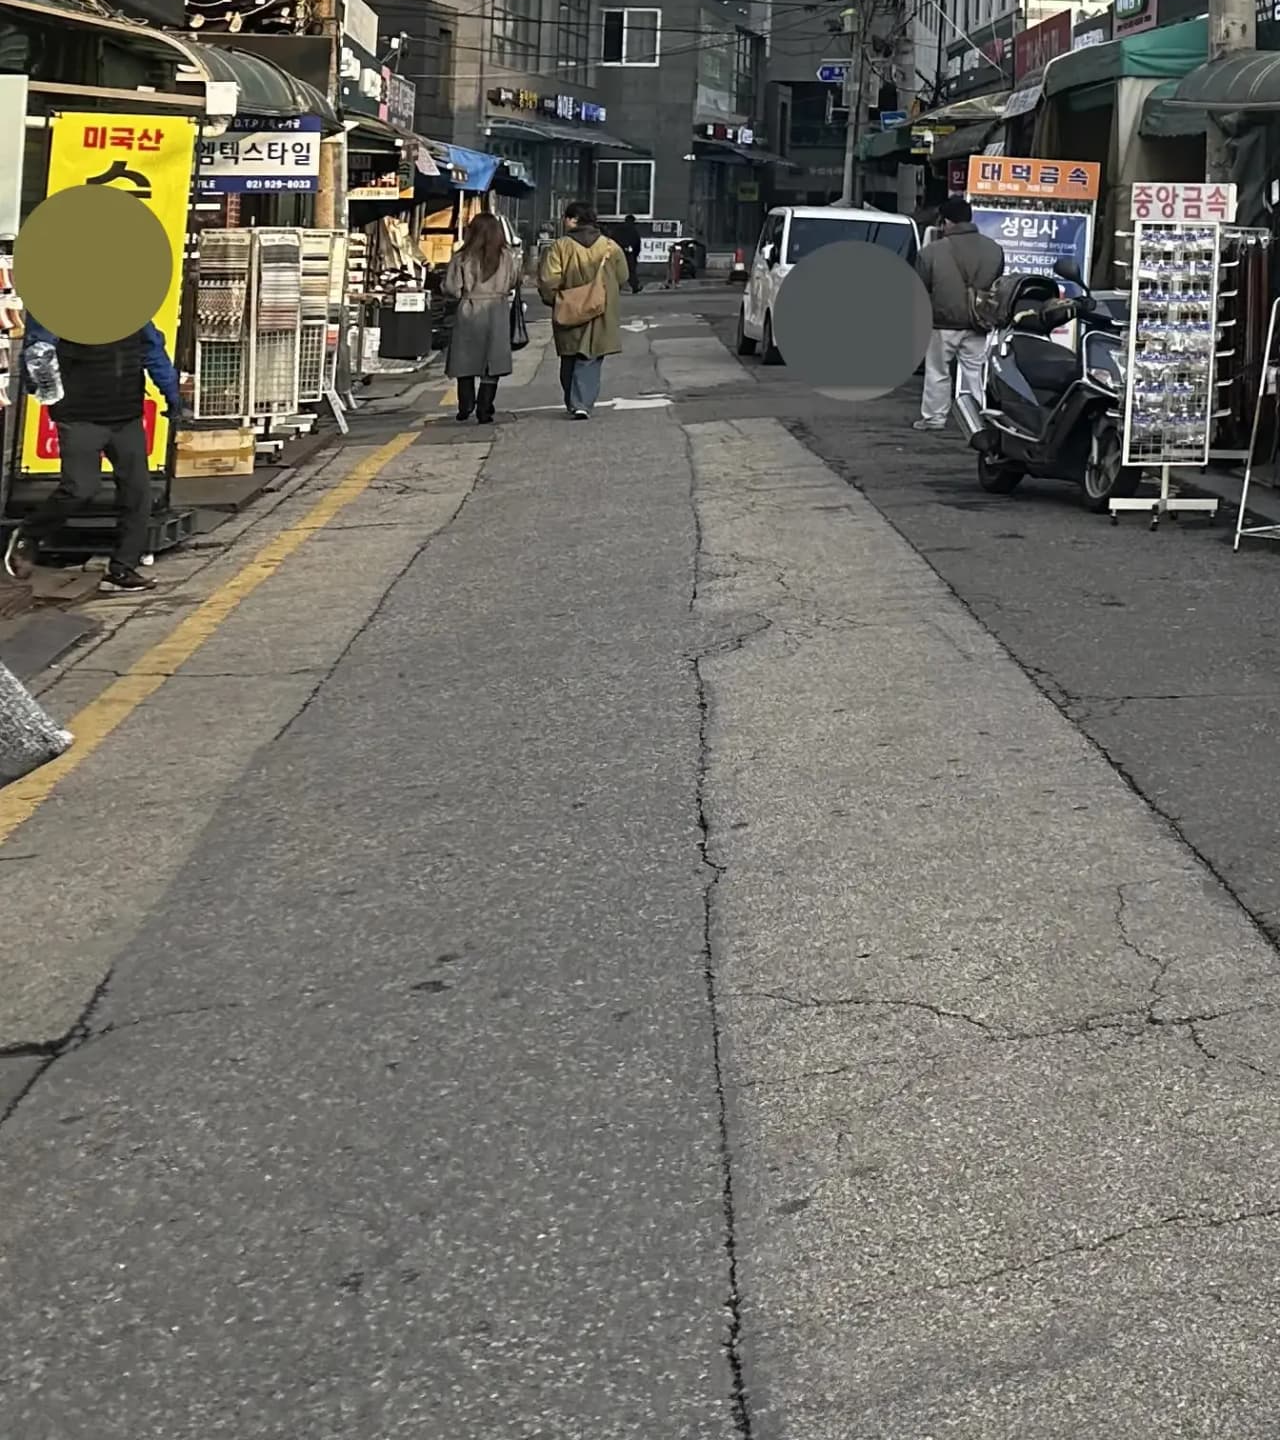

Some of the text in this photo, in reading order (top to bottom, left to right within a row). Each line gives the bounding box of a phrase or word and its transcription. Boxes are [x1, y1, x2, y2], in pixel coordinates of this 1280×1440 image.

[83, 126, 164, 151] 미국산
[194, 141, 311, 166] 엠텍스타일
[981, 162, 1089, 186] 대덕금속
[1133, 185, 1227, 220] 중앙금속
[1001, 217, 1059, 239] 성일사
[1003, 253, 1058, 265] ILKSCREEN
